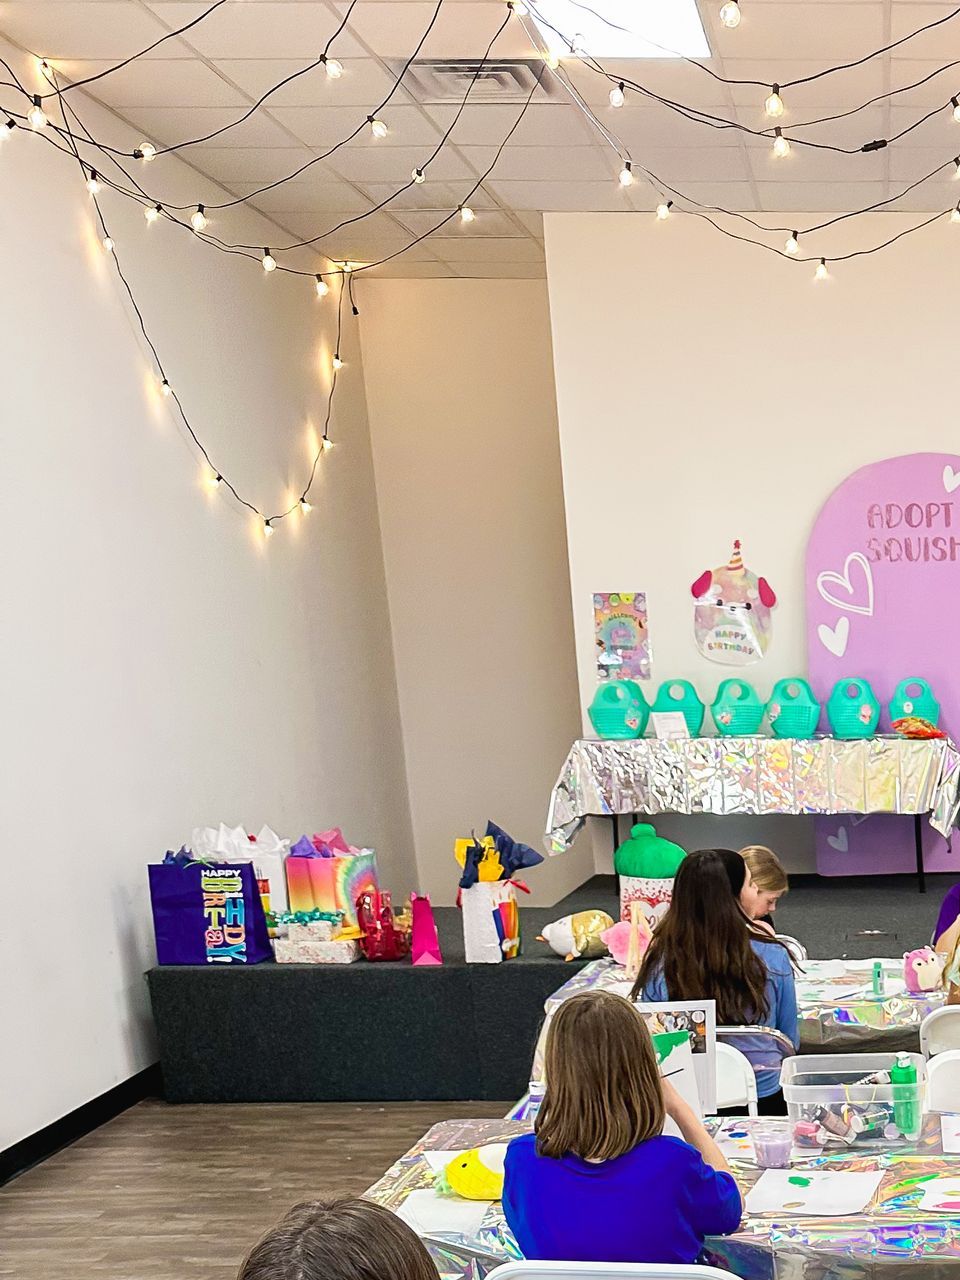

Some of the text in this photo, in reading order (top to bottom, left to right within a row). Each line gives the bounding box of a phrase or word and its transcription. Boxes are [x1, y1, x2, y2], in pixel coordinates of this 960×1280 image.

[867, 502, 954, 528] ADOPT
[715, 630, 748, 640] HAPPY
[707, 642, 755, 655] BIRTHDAY
[201, 869, 241, 877] HAPPY
